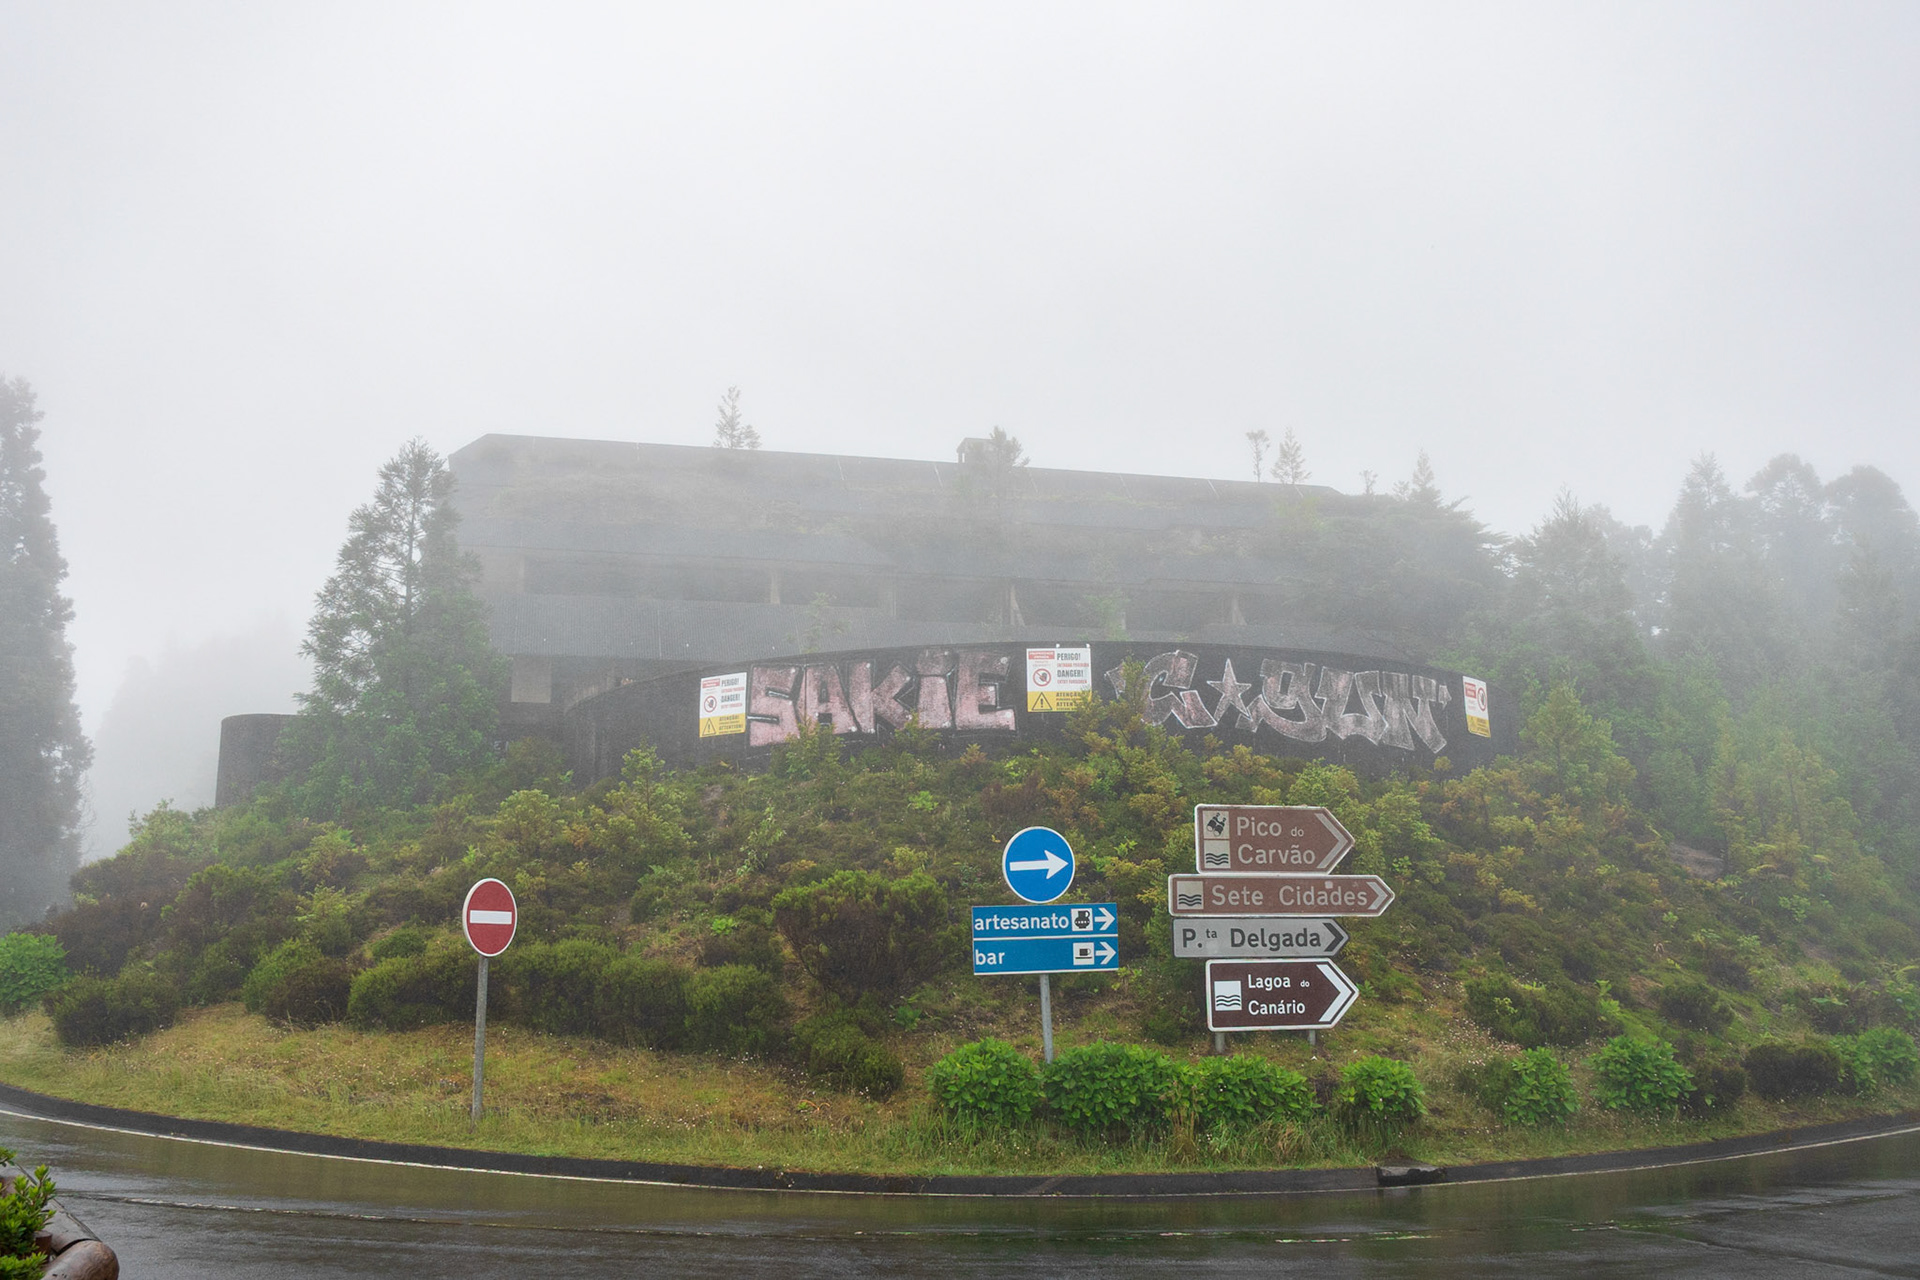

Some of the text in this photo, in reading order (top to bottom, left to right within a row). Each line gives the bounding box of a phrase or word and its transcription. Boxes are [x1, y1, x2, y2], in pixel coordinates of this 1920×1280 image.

[1057, 653, 1081, 661] PERIGO!
[1057, 669, 1084, 678] DANGER!
[1236, 816, 1305, 837] Pico do
[1237, 844, 1316, 865] Carvão
[1211, 885, 1368, 906] Sete Cidades
[974, 913, 1069, 931] artesanato
[1230, 928, 1321, 951] Delgada
[975, 949, 1006, 965] bar
[1248, 974, 1310, 991] Lagoa do
[1248, 1000, 1306, 1016] Canário
